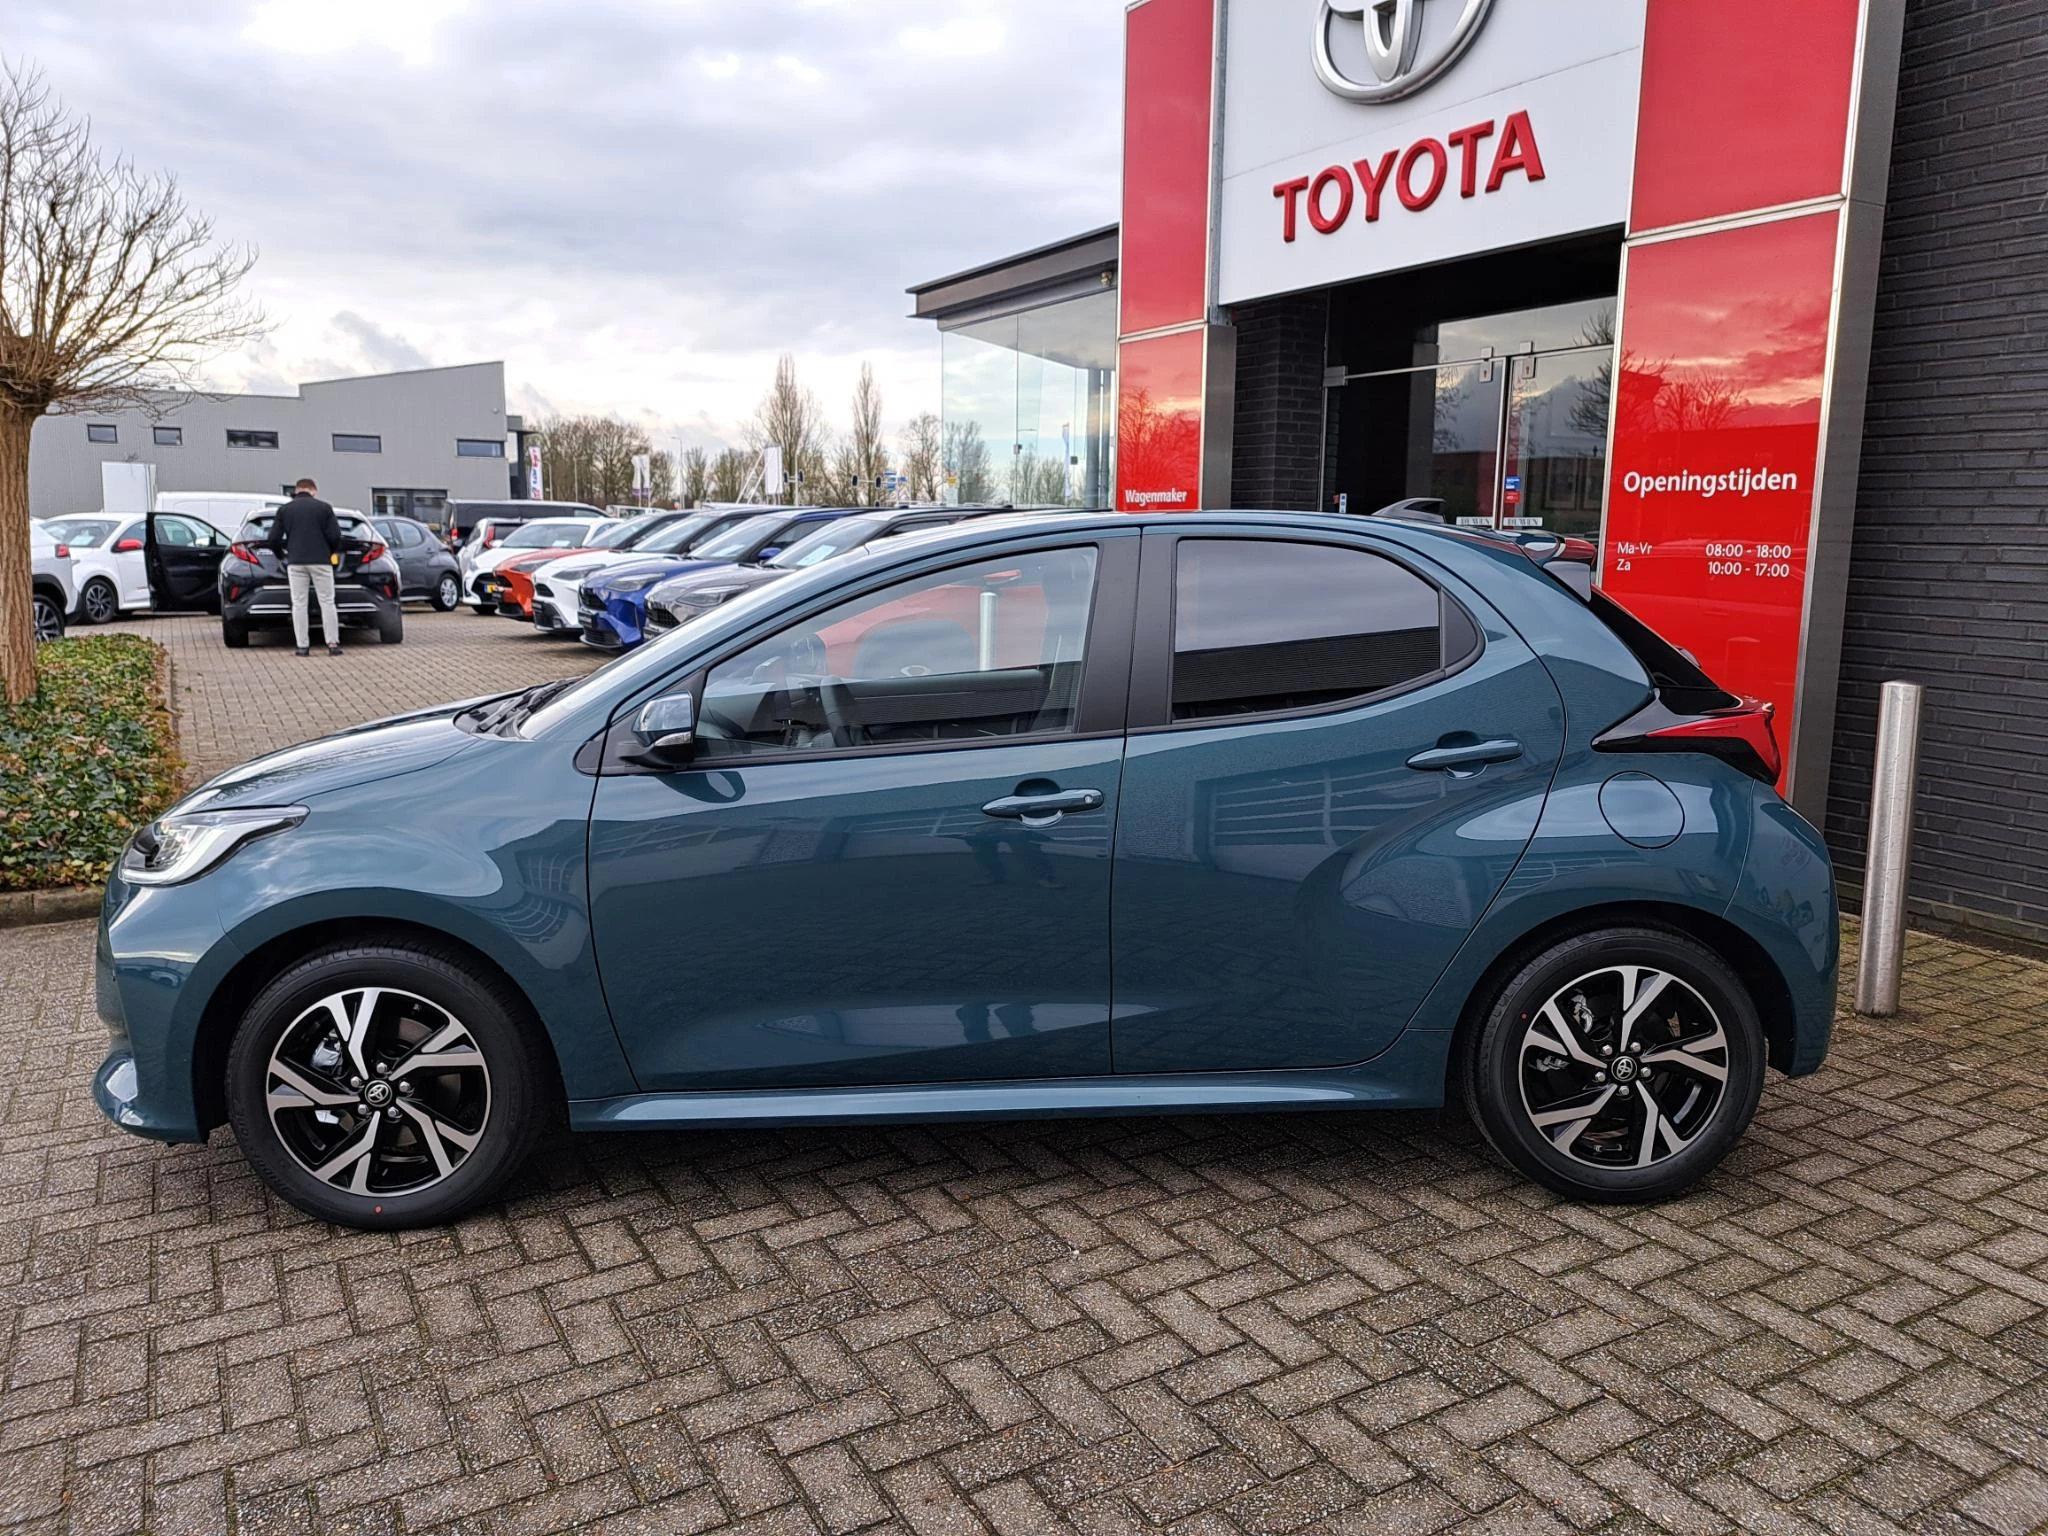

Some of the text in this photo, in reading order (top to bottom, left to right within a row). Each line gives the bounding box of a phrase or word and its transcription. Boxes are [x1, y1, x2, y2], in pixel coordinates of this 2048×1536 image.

[1273, 109, 1546, 243] TOYOTA
[1623, 467, 1798, 498] Openingstijden
[1125, 487, 1188, 507] Wagenmaker
[1617, 541, 1653, 555] Ma-Vr
[1705, 543, 1743, 557] 08:00
[1756, 544, 1792, 559] 18:00
[1616, 558, 1631, 571] Za
[1708, 561, 1742, 575] 10:00
[1755, 563, 1790, 578] 17:00
